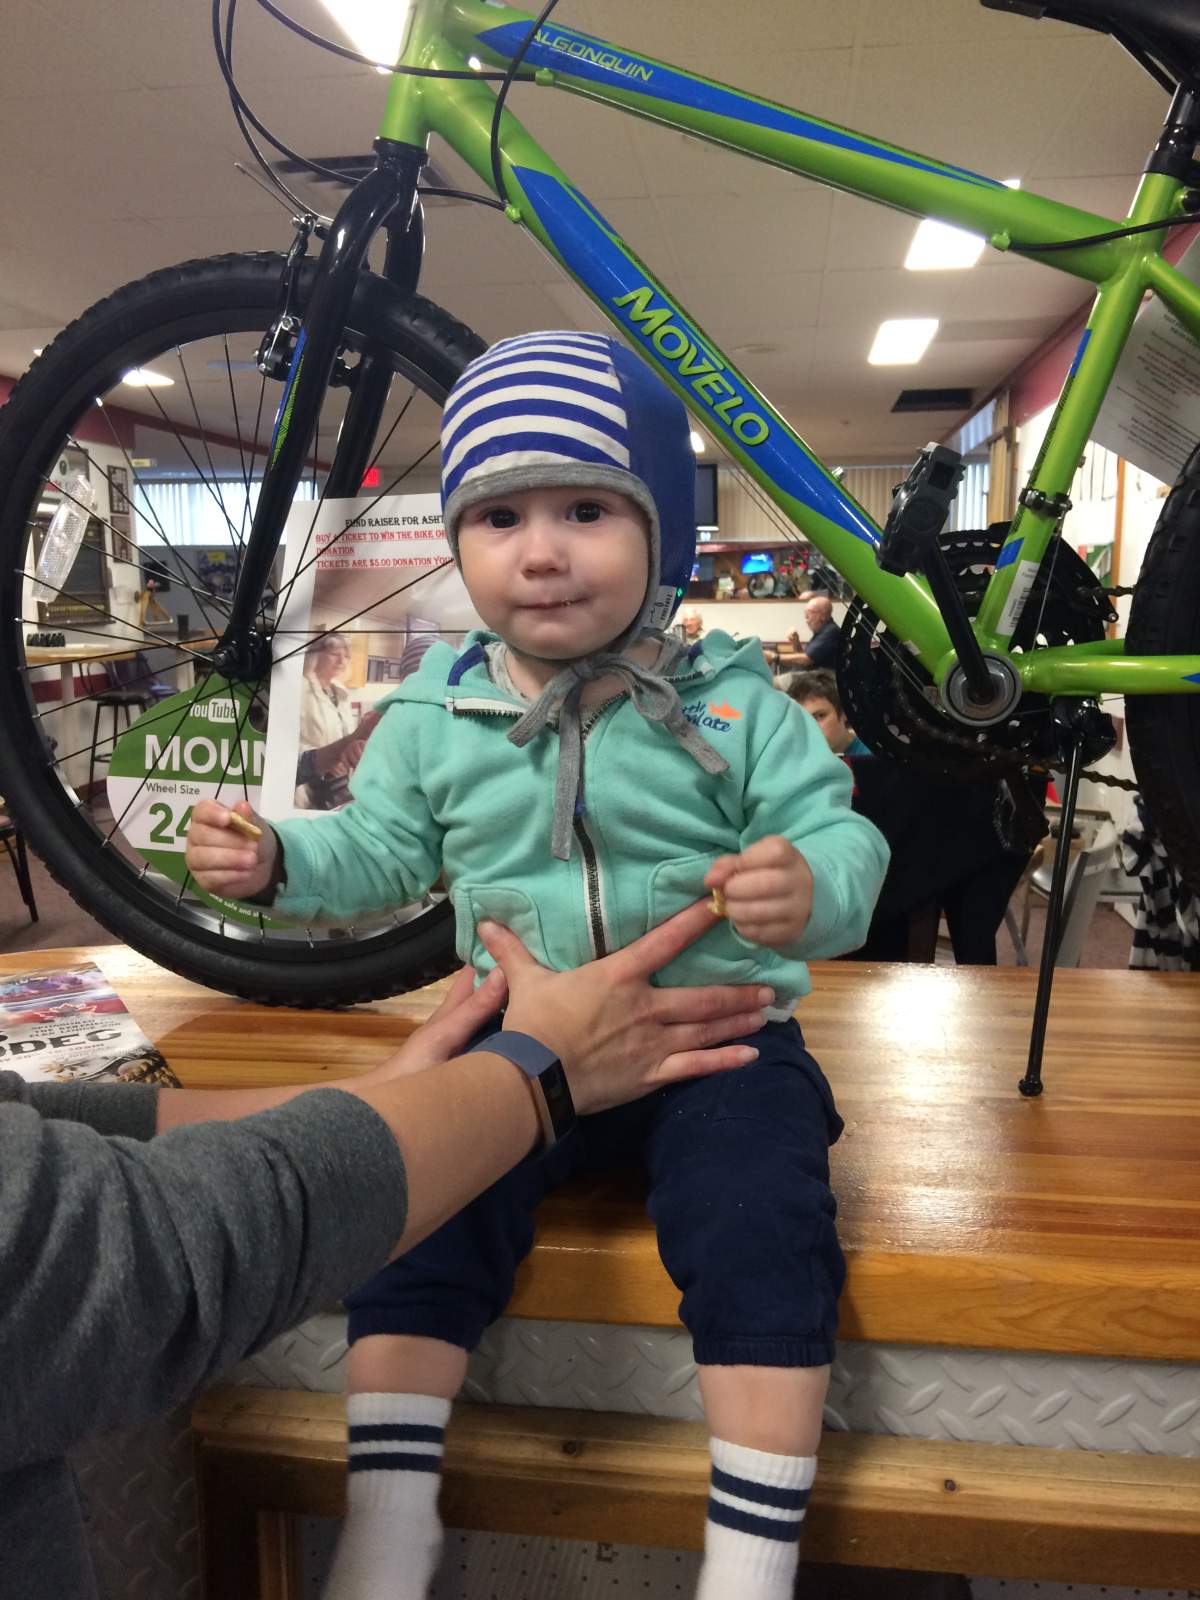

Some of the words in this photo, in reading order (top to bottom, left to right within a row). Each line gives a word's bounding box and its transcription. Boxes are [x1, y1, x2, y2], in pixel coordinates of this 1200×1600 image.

[534, 28, 654, 81] ALGONQUIN
[612, 286, 770, 446] MOVELO
[368, 517, 400, 527] RAISER
[402, 516, 419, 526] FOR
[316, 533, 331, 543] BUY
[341, 533, 367, 542] TICKET
[369, 532, 379, 541] TO
[380, 531, 395, 540] WIN
[397, 531, 412, 540] THE
[414, 530, 433, 539] BIKE
[316, 560, 350, 569] TICKETS
[352, 559, 368, 568] ARE
[393, 557, 432, 567] DONATION
[145, 782, 177, 794] Wheel
[180, 784, 201, 796] Size
